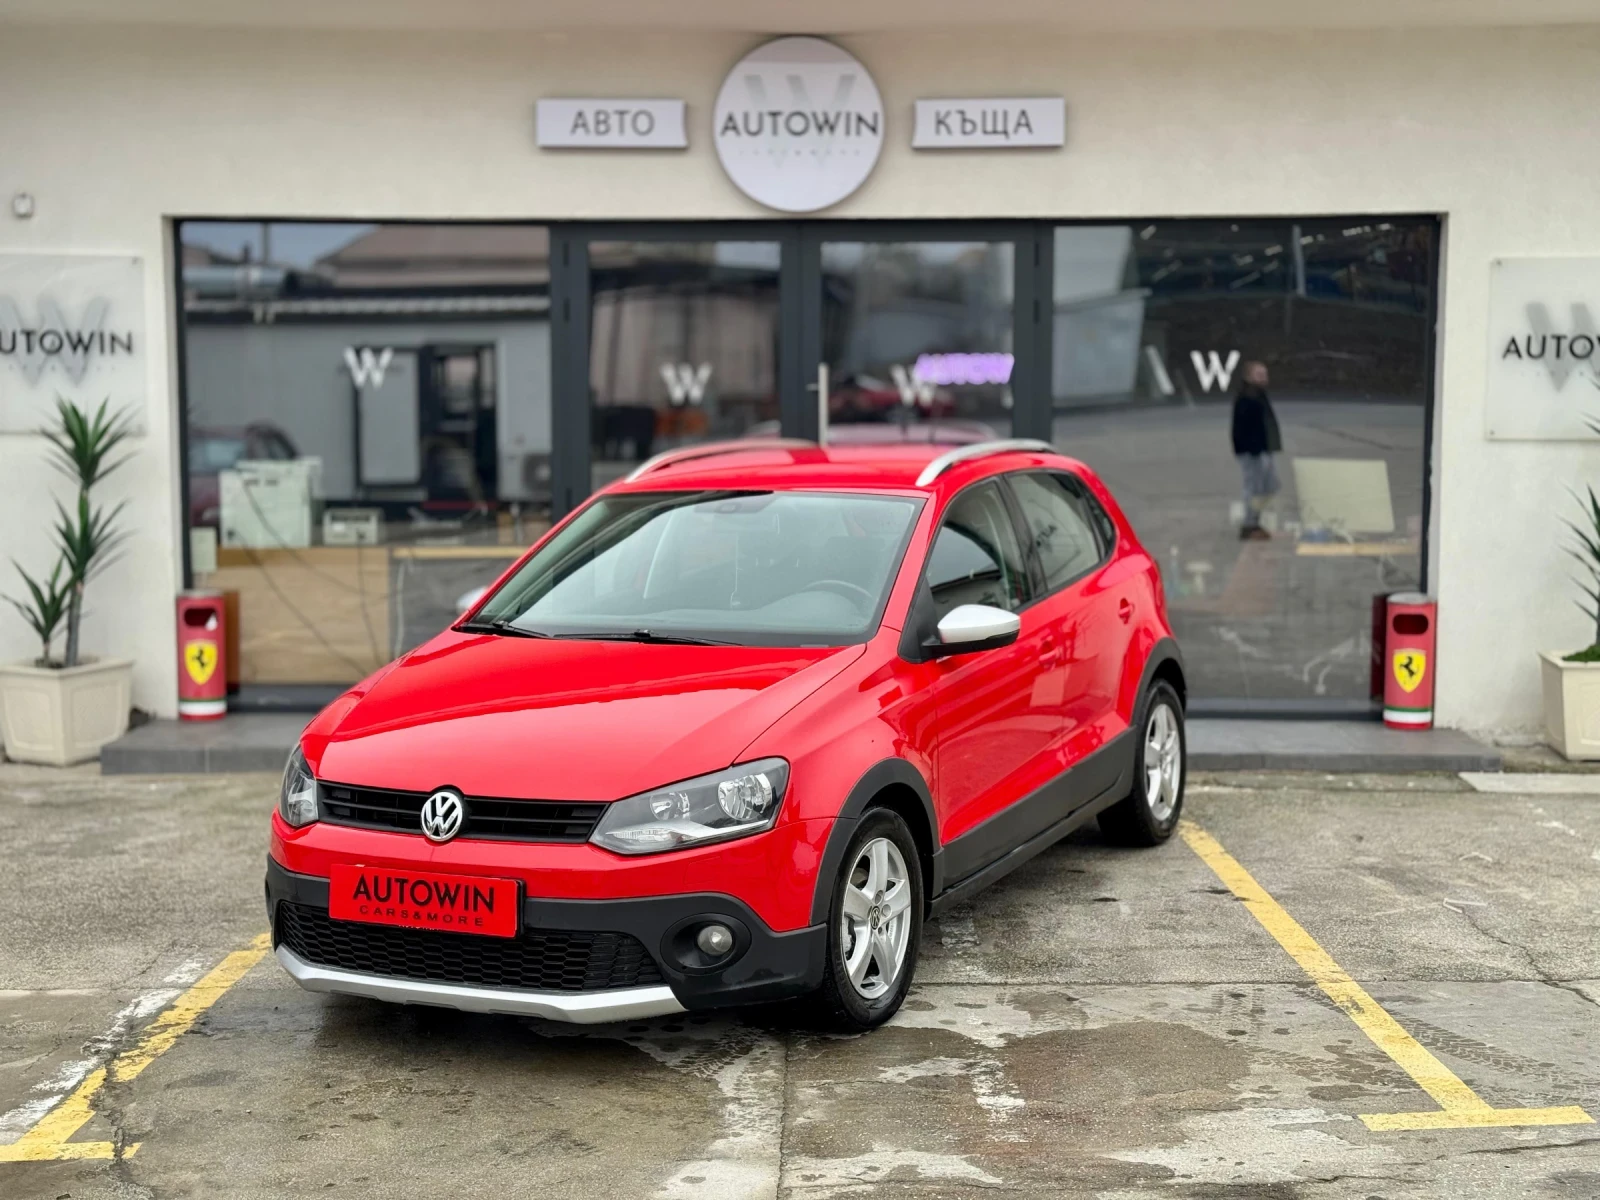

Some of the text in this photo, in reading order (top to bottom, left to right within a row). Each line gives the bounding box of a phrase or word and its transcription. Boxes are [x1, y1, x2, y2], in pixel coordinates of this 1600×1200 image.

[570, 110, 655, 136] АВТО
[720, 110, 879, 137] AUTOWIN
[934, 109, 1035, 141] КЪЩА
[0, 329, 134, 356] UTOWIN
[1502, 333, 1600, 361] AUTO
[343, 345, 394, 389] W
[1189, 349, 1241, 393] W
[660, 362, 712, 405] W
[352, 873, 496, 915] AUTOWIN
[358, 904, 485, 927] CARS&MORE
